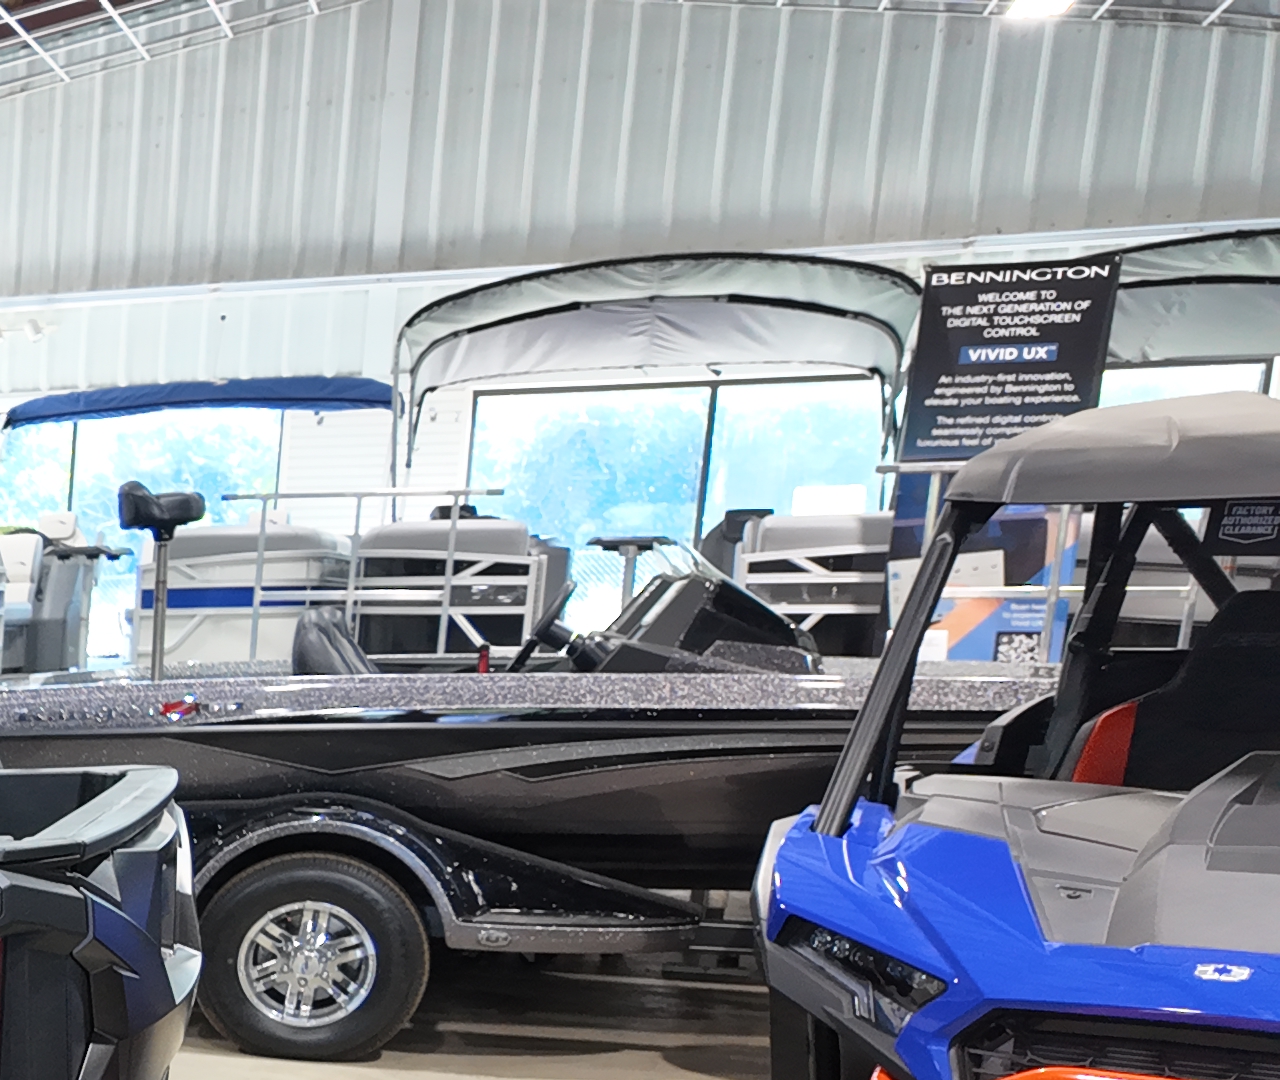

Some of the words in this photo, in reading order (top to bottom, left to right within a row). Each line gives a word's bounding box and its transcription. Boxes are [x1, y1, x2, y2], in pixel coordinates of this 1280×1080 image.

[931, 265, 1111, 286] BENNINGTON
[977, 290, 1038, 303] WELCOME
[1040, 290, 1057, 301] TO
[941, 306, 964, 316] THE
[965, 304, 996, 315] NEXT
[997, 301, 1072, 315] GENERATION
[1073, 300, 1092, 310] OF
[946, 317, 990, 328] DIGITAL
[993, 313, 1082, 326] TOUCHSCREEN
[982, 327, 1041, 338] CONTROL
[968, 347, 1019, 362] VIVID
